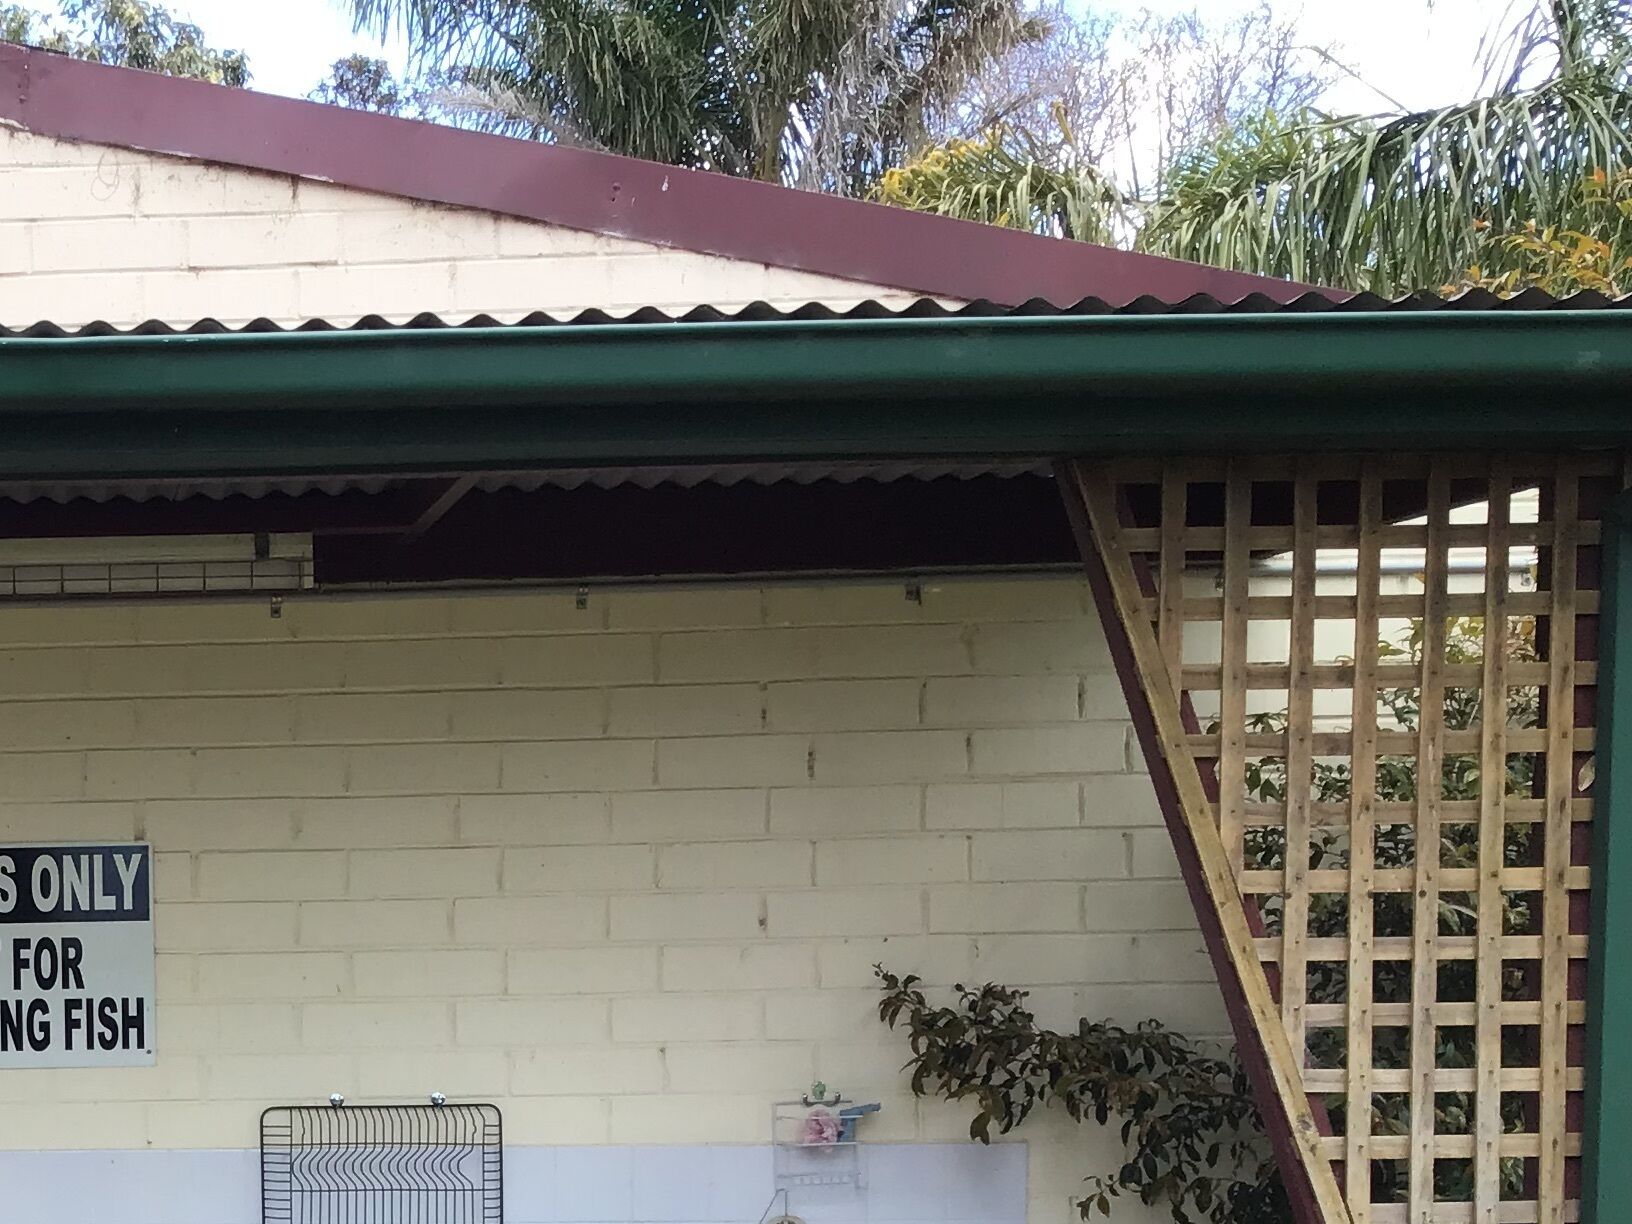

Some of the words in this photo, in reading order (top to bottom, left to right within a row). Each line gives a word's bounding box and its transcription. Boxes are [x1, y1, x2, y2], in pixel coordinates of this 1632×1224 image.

[31, 853, 142, 913] ONLY
[12, 936, 85, 991] FOR
[64, 997, 145, 1051] FISH
